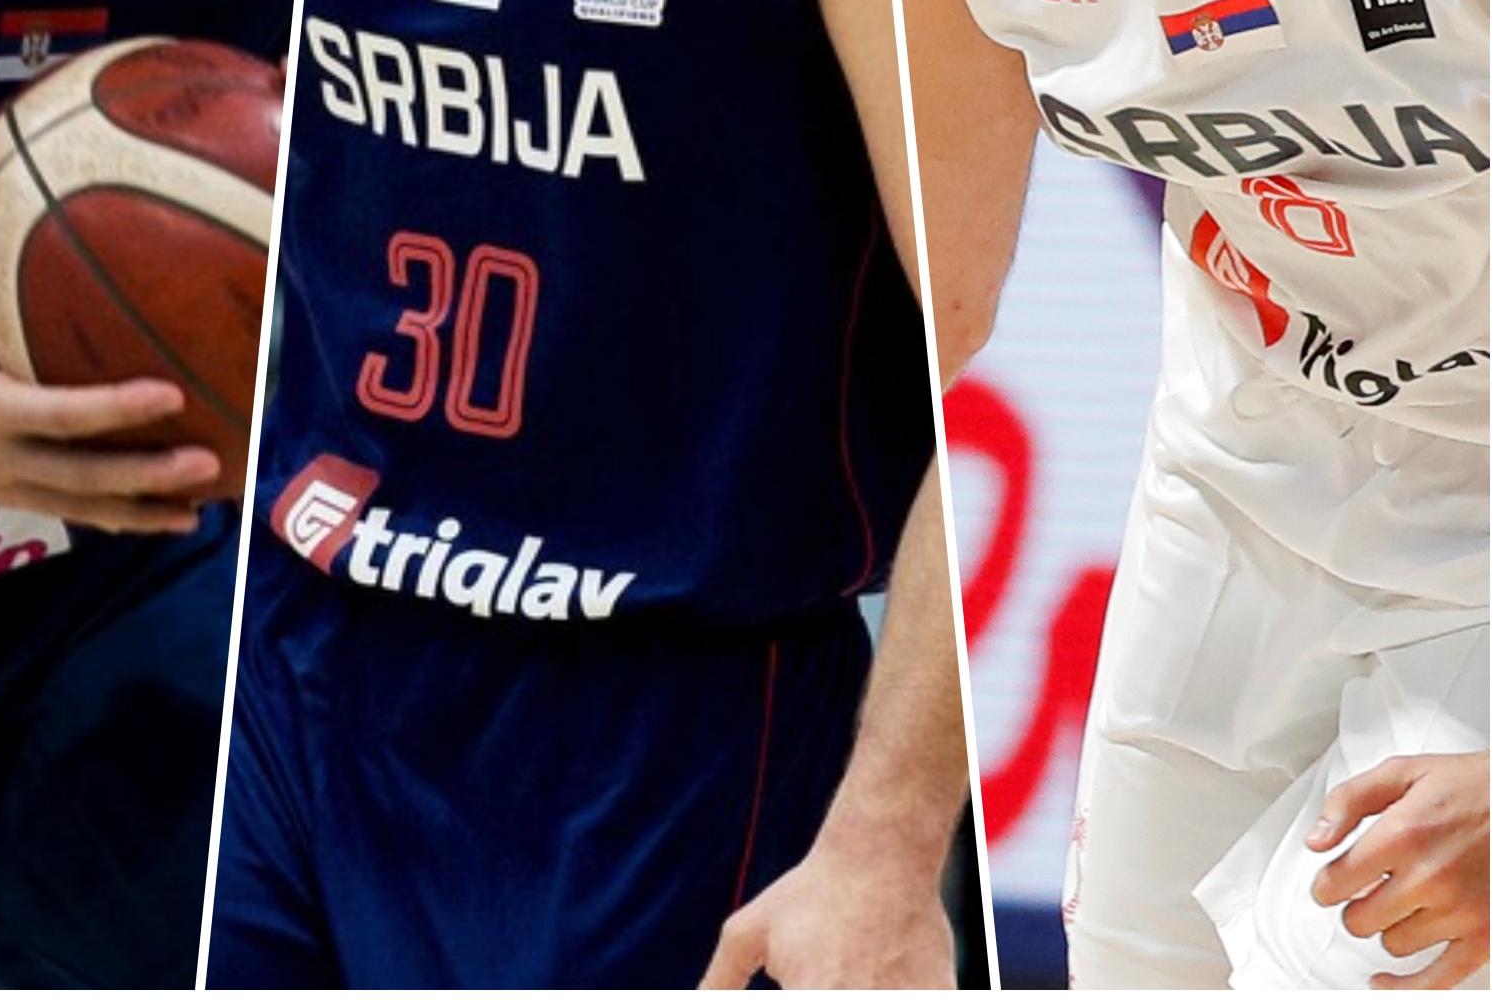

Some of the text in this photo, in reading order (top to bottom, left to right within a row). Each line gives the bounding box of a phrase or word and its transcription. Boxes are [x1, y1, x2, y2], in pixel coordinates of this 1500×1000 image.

[306, 16, 646, 182] SRBIJA
[1038, 94, 1491, 178] SRBIJA
[355, 231, 541, 439] 30
